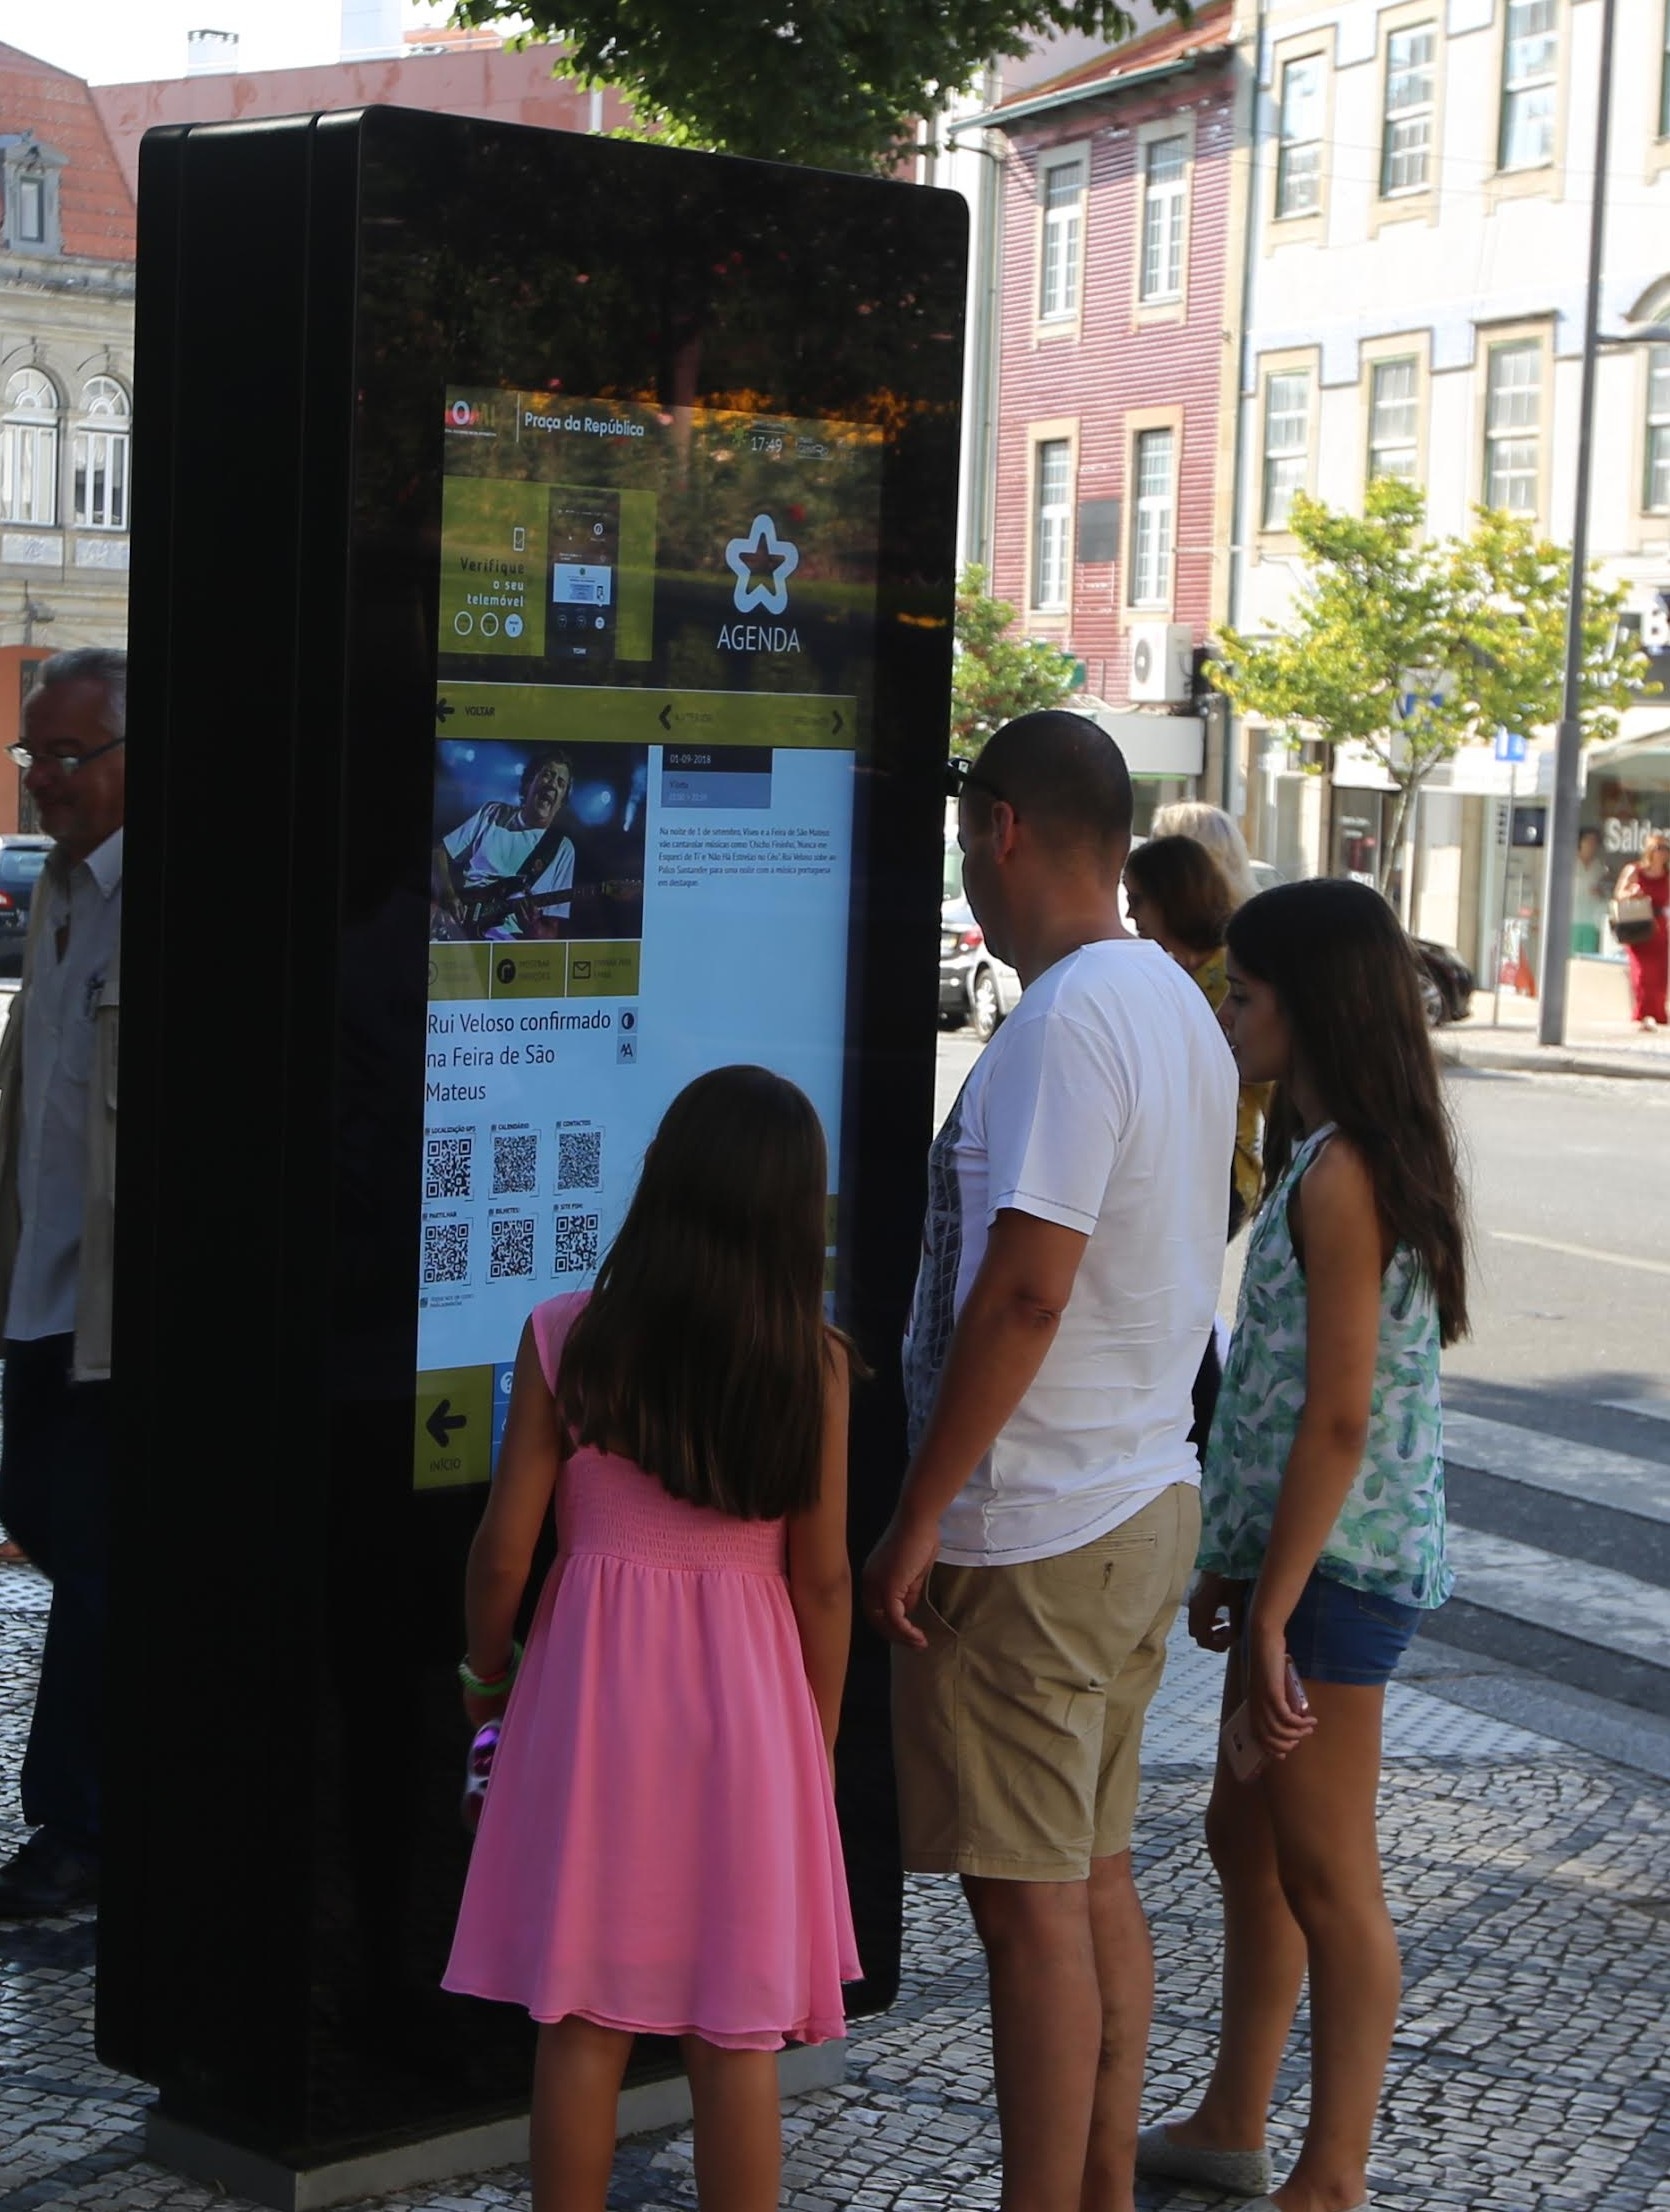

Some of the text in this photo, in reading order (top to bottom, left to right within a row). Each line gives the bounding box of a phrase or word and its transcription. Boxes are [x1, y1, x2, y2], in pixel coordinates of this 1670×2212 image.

[525, 411, 644, 437] Praça da República
[459, 556, 525, 576] Verifique
[493, 580, 524, 591] o seu
[466, 593, 524, 607] telemóvel
[717, 625, 801, 653] AGENDA
[465, 705, 495, 717] VOLTAR
[428, 1010, 611, 1034] Rui Veloso confirmado
[426, 1044, 555, 1067] na Feira de São
[426, 1082, 486, 1102] Mateus
[429, 1457, 462, 1472] INÍCIO
